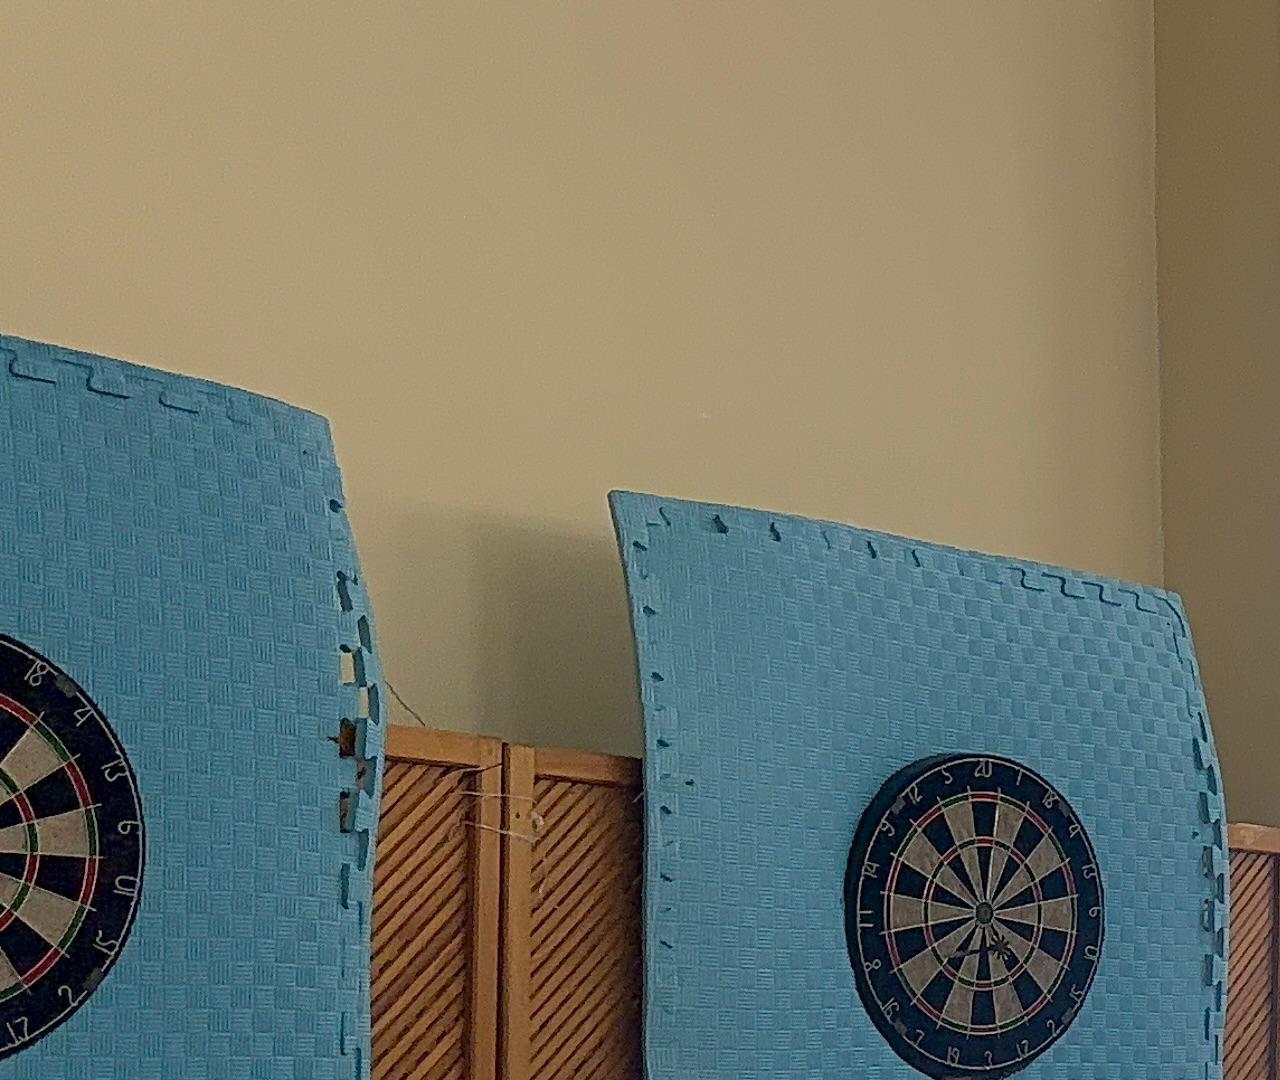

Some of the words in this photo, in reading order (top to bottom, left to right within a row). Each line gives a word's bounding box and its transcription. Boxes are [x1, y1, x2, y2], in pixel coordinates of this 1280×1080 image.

[24, 660, 50, 686] 18
[101, 758, 128, 782] 13
[975, 759, 992, 777] 20
[113, 875, 138, 897] 10
[93, 930, 118, 956] 15
[6, 1016, 29, 1045] 17
